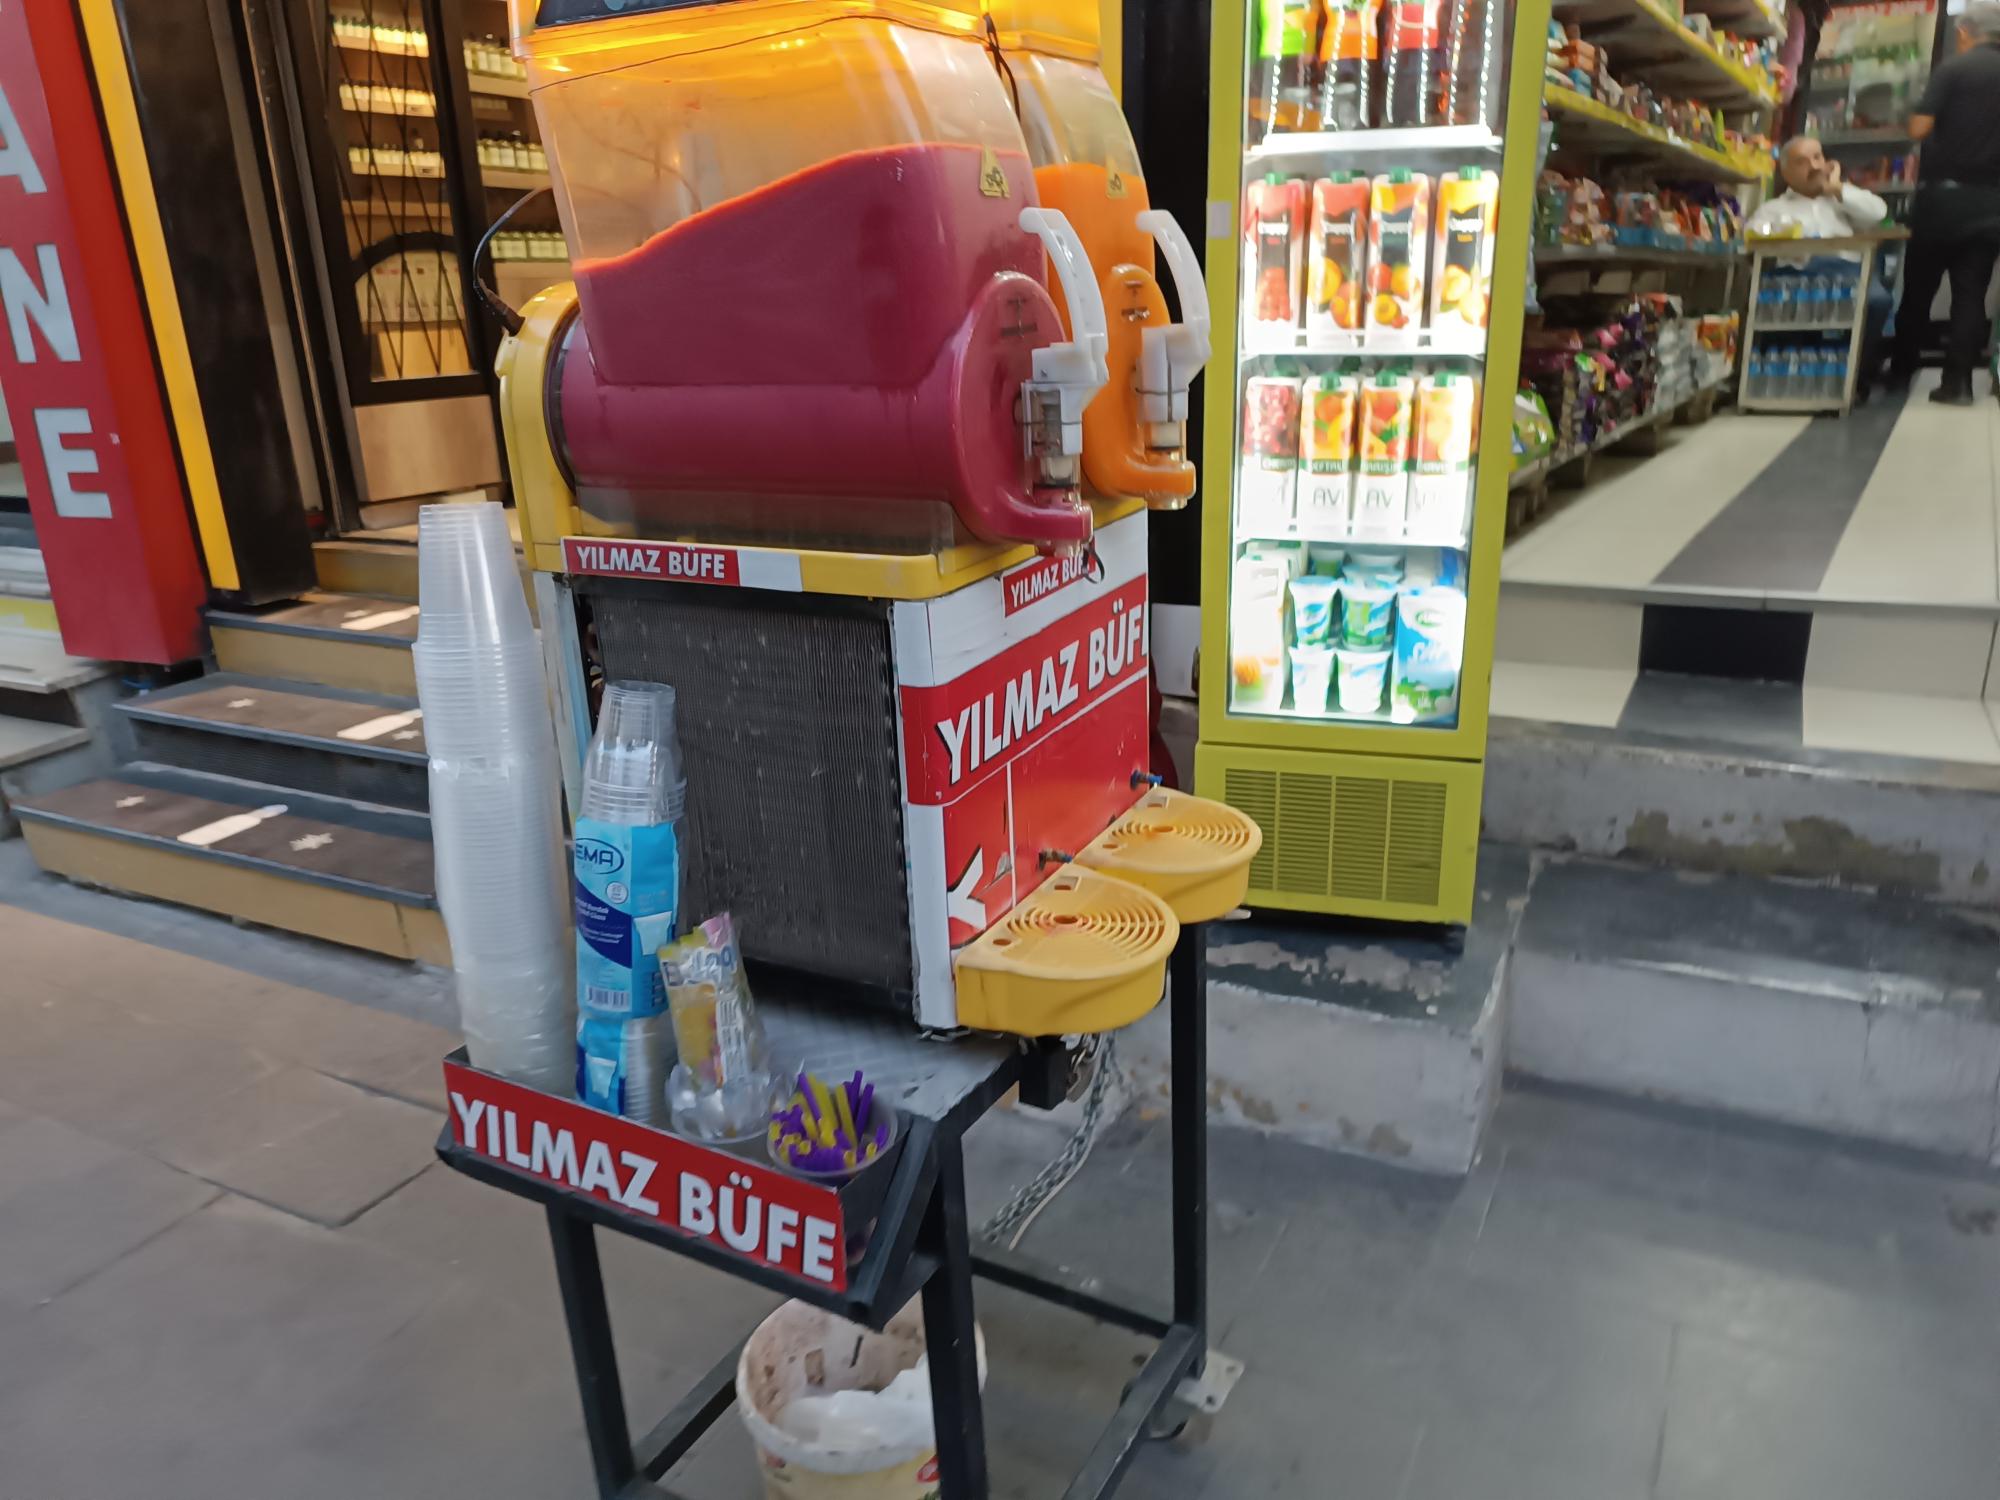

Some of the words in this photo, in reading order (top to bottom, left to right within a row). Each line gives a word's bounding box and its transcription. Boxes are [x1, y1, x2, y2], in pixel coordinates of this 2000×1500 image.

[576, 545, 661, 573] YILMAZ
[668, 545, 725, 578] BÜFE
[1010, 562, 1059, 608] YILMAZ
[936, 639, 1080, 784] YILMAZ
[450, 1091, 660, 1217] YILMAZ
[679, 1170, 837, 1283] BÜFE
